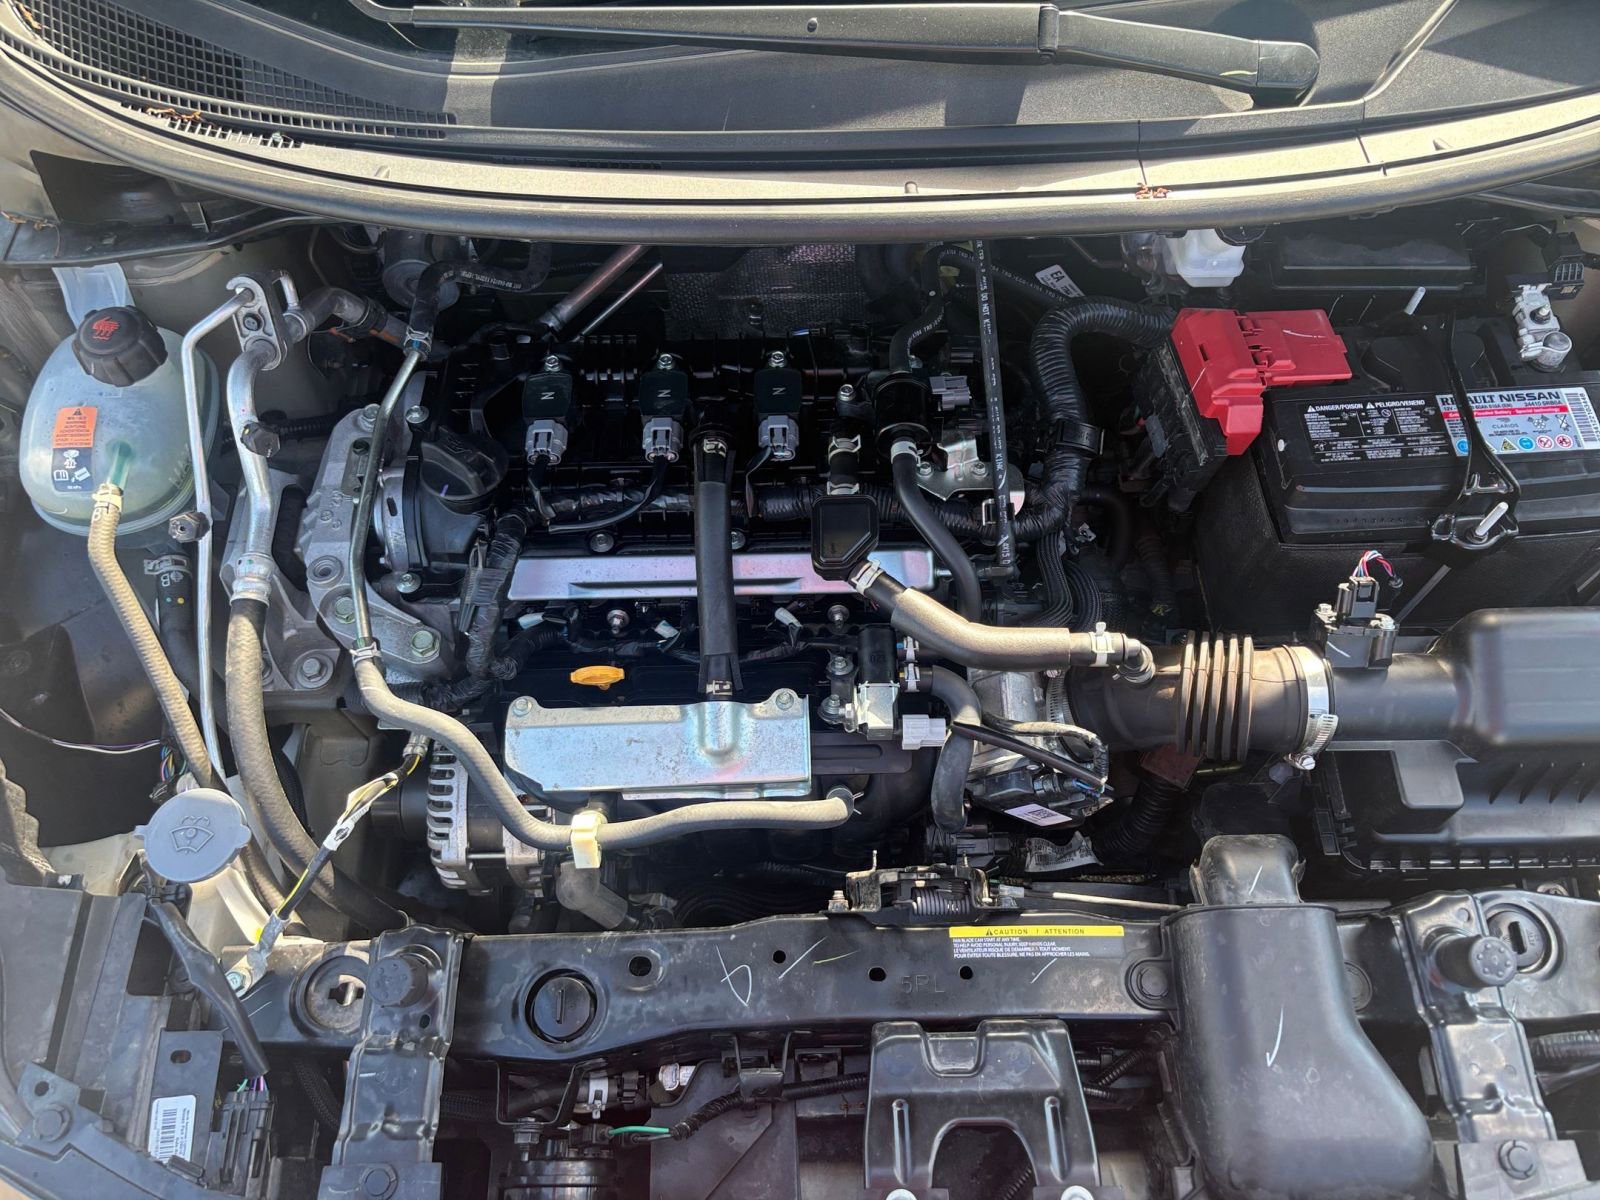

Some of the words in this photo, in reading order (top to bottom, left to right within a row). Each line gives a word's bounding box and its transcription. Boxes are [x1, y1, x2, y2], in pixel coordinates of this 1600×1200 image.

[1441, 394, 1495, 405] REAULT
[1499, 391, 1561, 403] NISSAN
[1315, 403, 1364, 412] DANGER/POISON
[1375, 400, 1425, 408] PELIGRO/VENENO
[993, 928, 1029, 936] CAUTION
